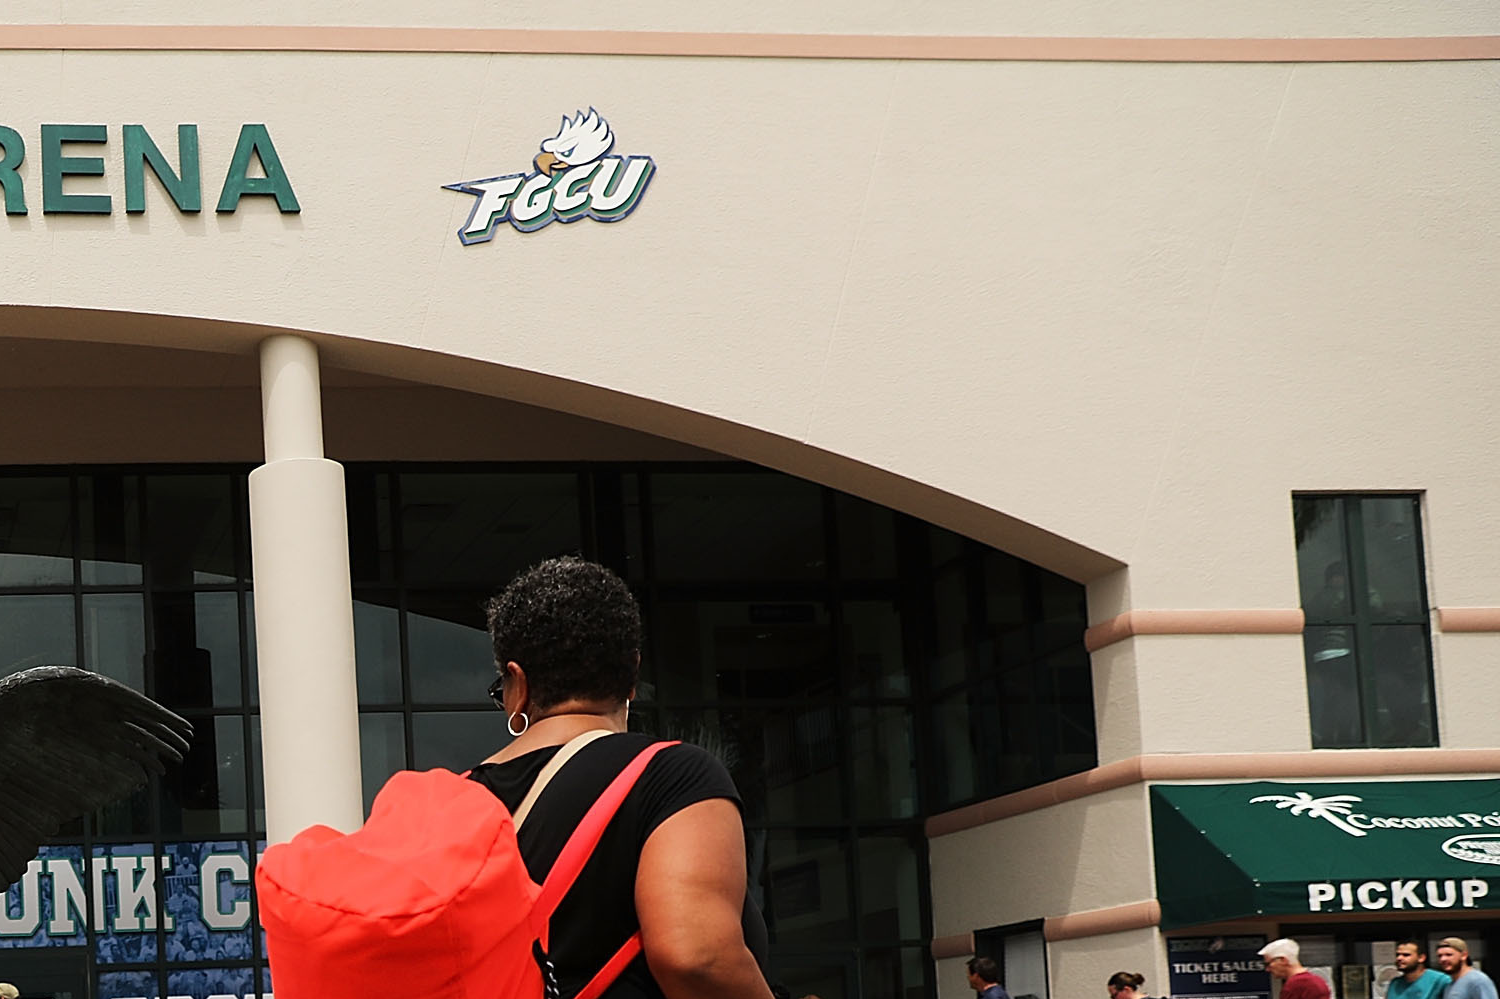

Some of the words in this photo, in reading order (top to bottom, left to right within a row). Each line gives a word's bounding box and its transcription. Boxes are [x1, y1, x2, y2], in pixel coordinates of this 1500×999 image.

[1346, 813, 1466, 829] Coconut
[1308, 879, 1489, 912] PICKUP
[1172, 961, 1219, 974] TICKET
[1221, 960, 1265, 972] SALES
[1201, 972, 1238, 984] HERE
